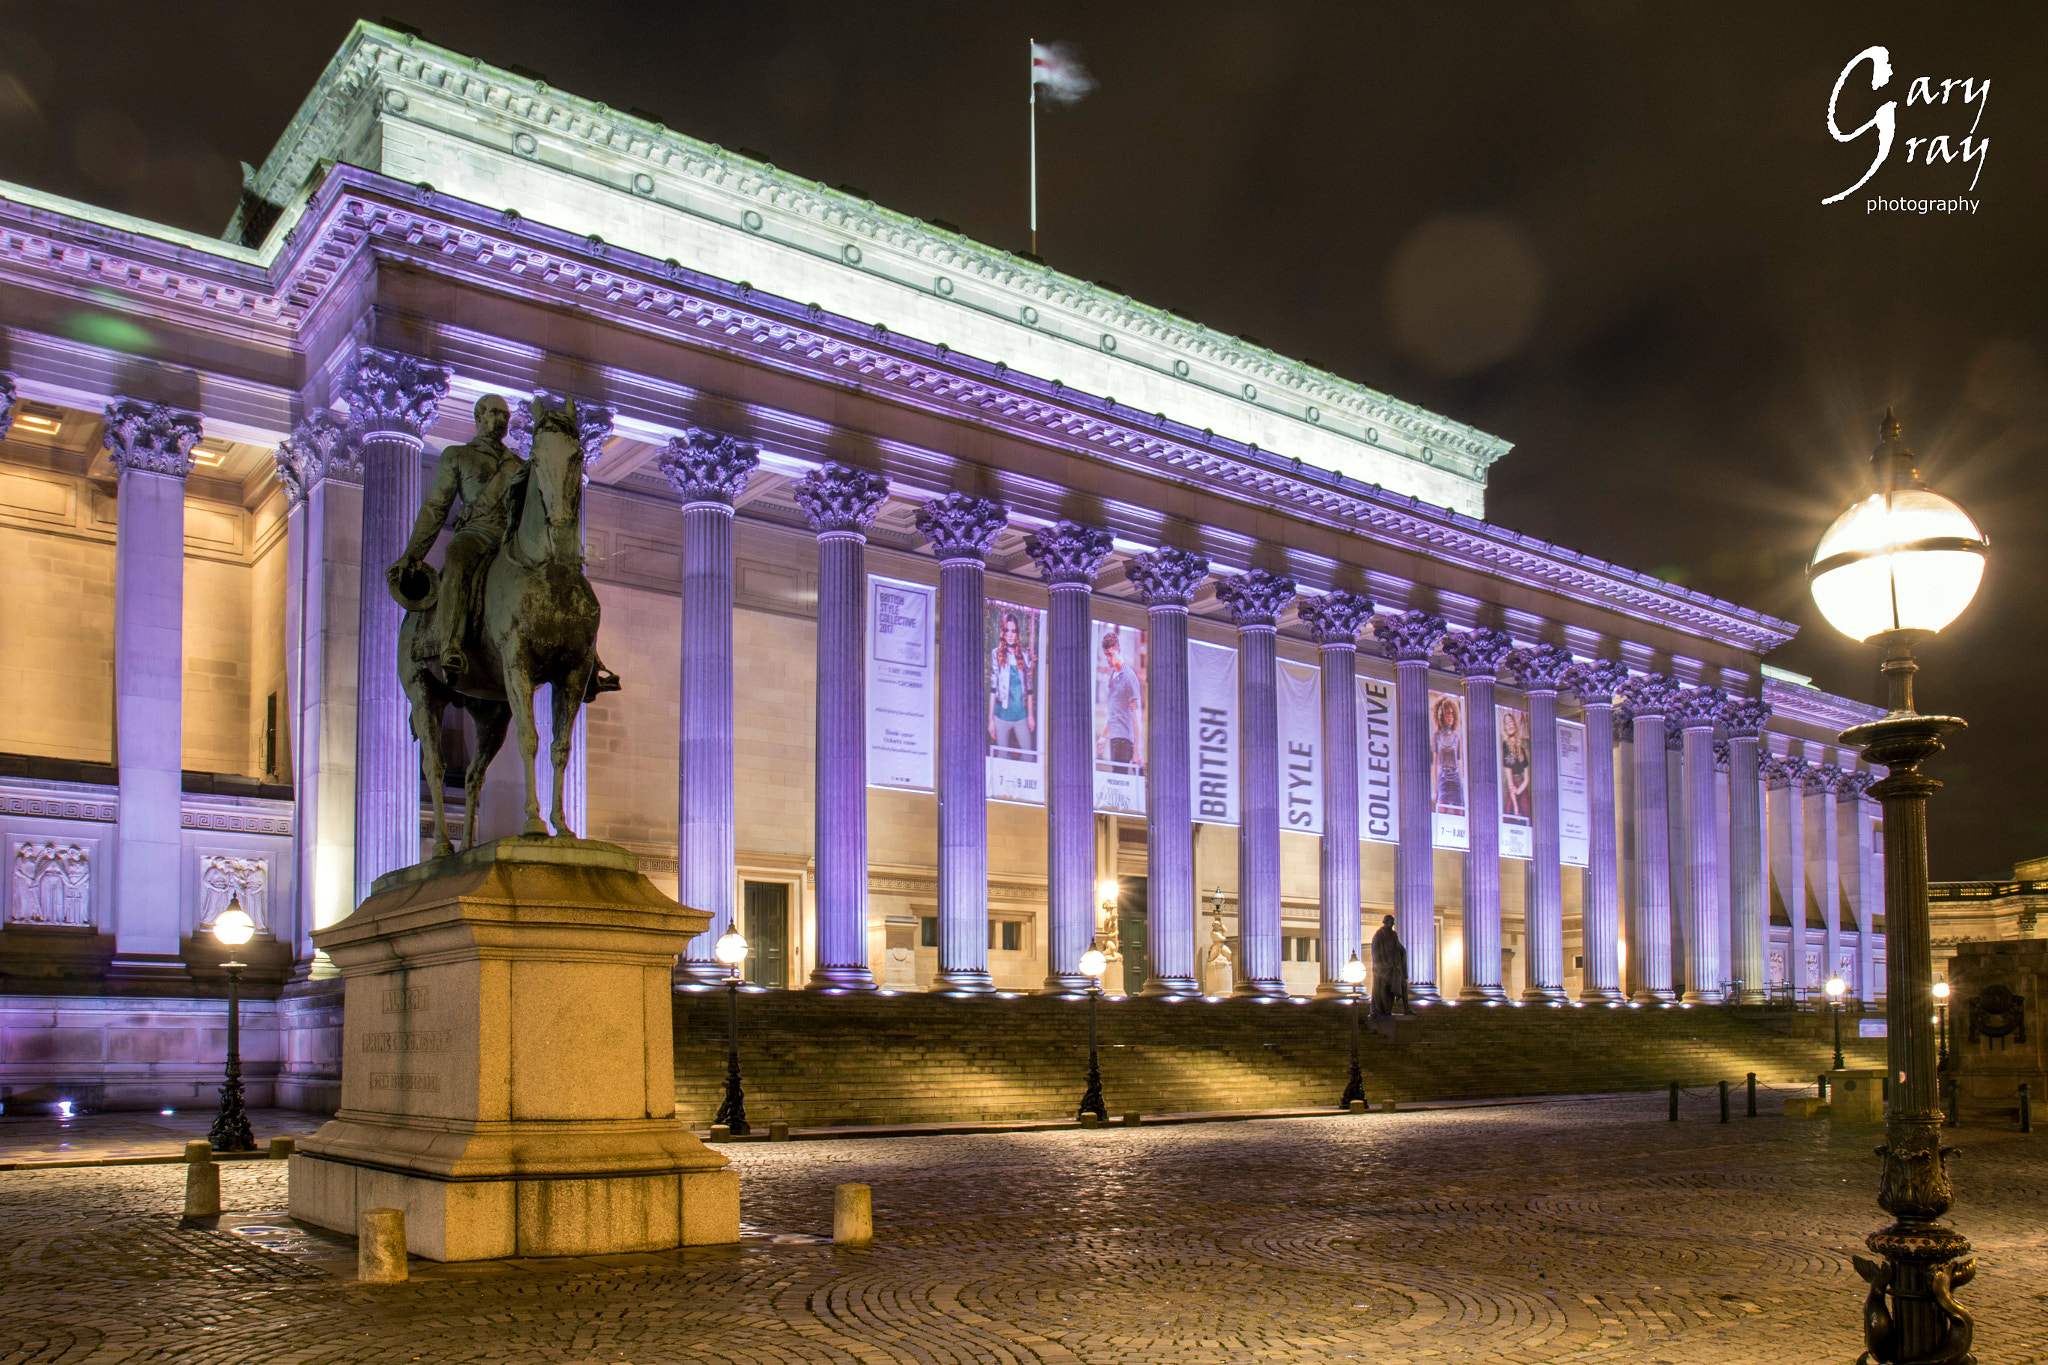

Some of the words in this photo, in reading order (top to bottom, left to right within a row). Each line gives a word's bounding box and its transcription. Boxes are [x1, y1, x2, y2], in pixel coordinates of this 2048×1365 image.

[879, 592, 905, 606] BRITISH
[879, 602, 900, 616] STYLE
[879, 613, 917, 629] COLLECTIVE
[1200, 707, 1228, 818] BRITISH
[1365, 682, 1390, 836] COLLECTIVE
[999, 775, 1004, 786] 7
[1017, 777, 1022, 788] 9
[1023, 779, 1038, 790] JULY
[1288, 740, 1313, 827] STYLE
